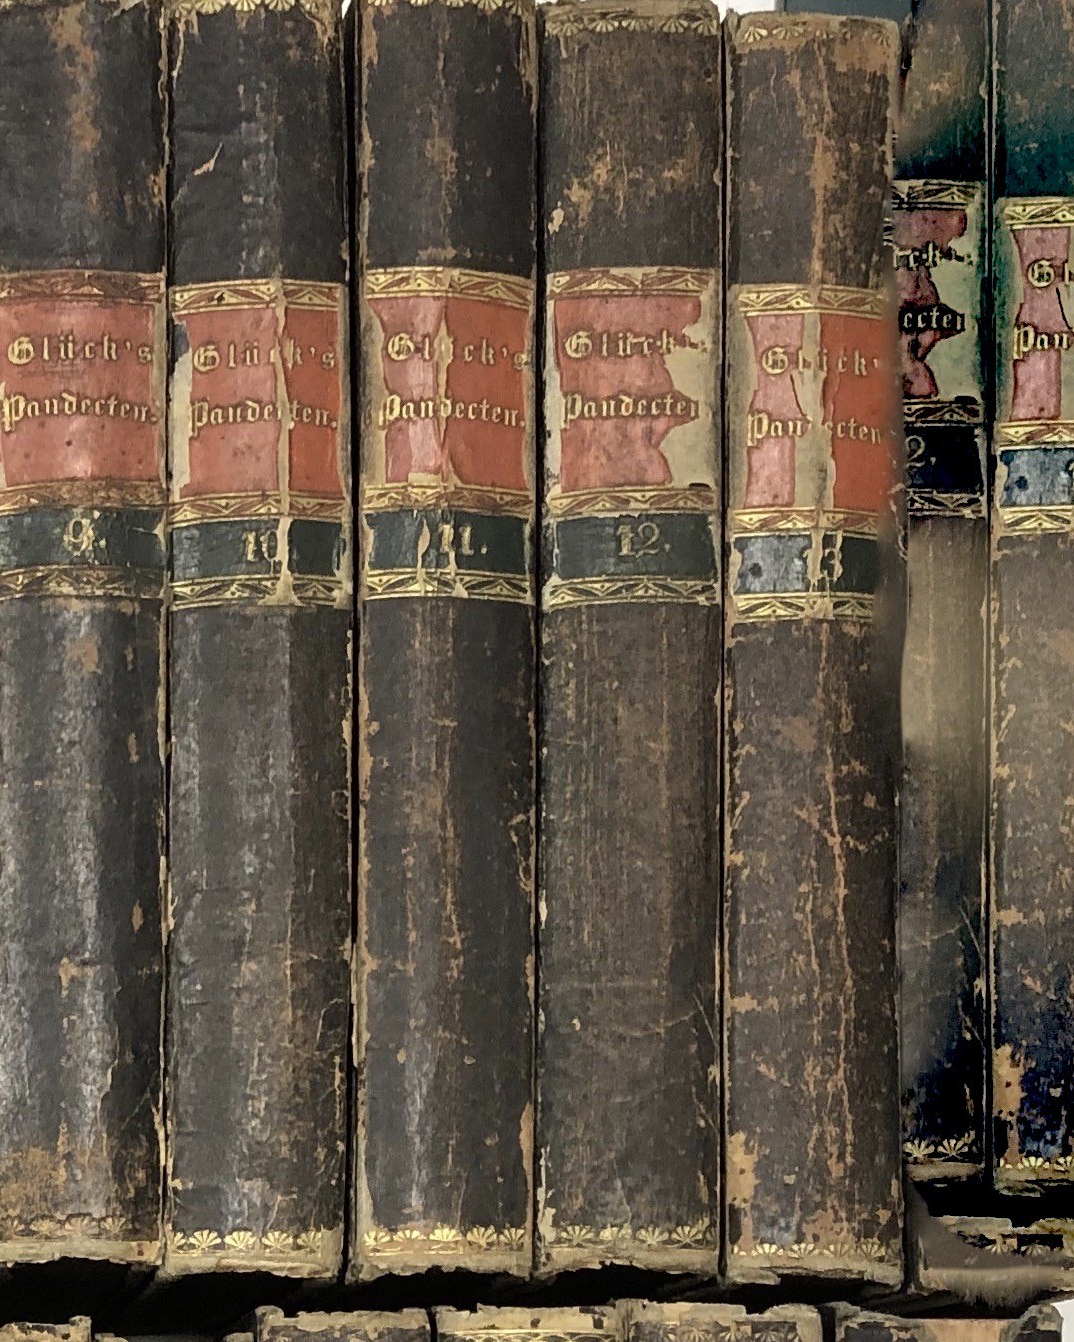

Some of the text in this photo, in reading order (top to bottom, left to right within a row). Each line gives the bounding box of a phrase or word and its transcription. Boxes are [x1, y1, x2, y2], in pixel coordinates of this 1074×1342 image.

[7, 335, 153, 365] Glück's
[1, 393, 159, 432] Pandecten.
[616, 522, 672, 558] 12.
